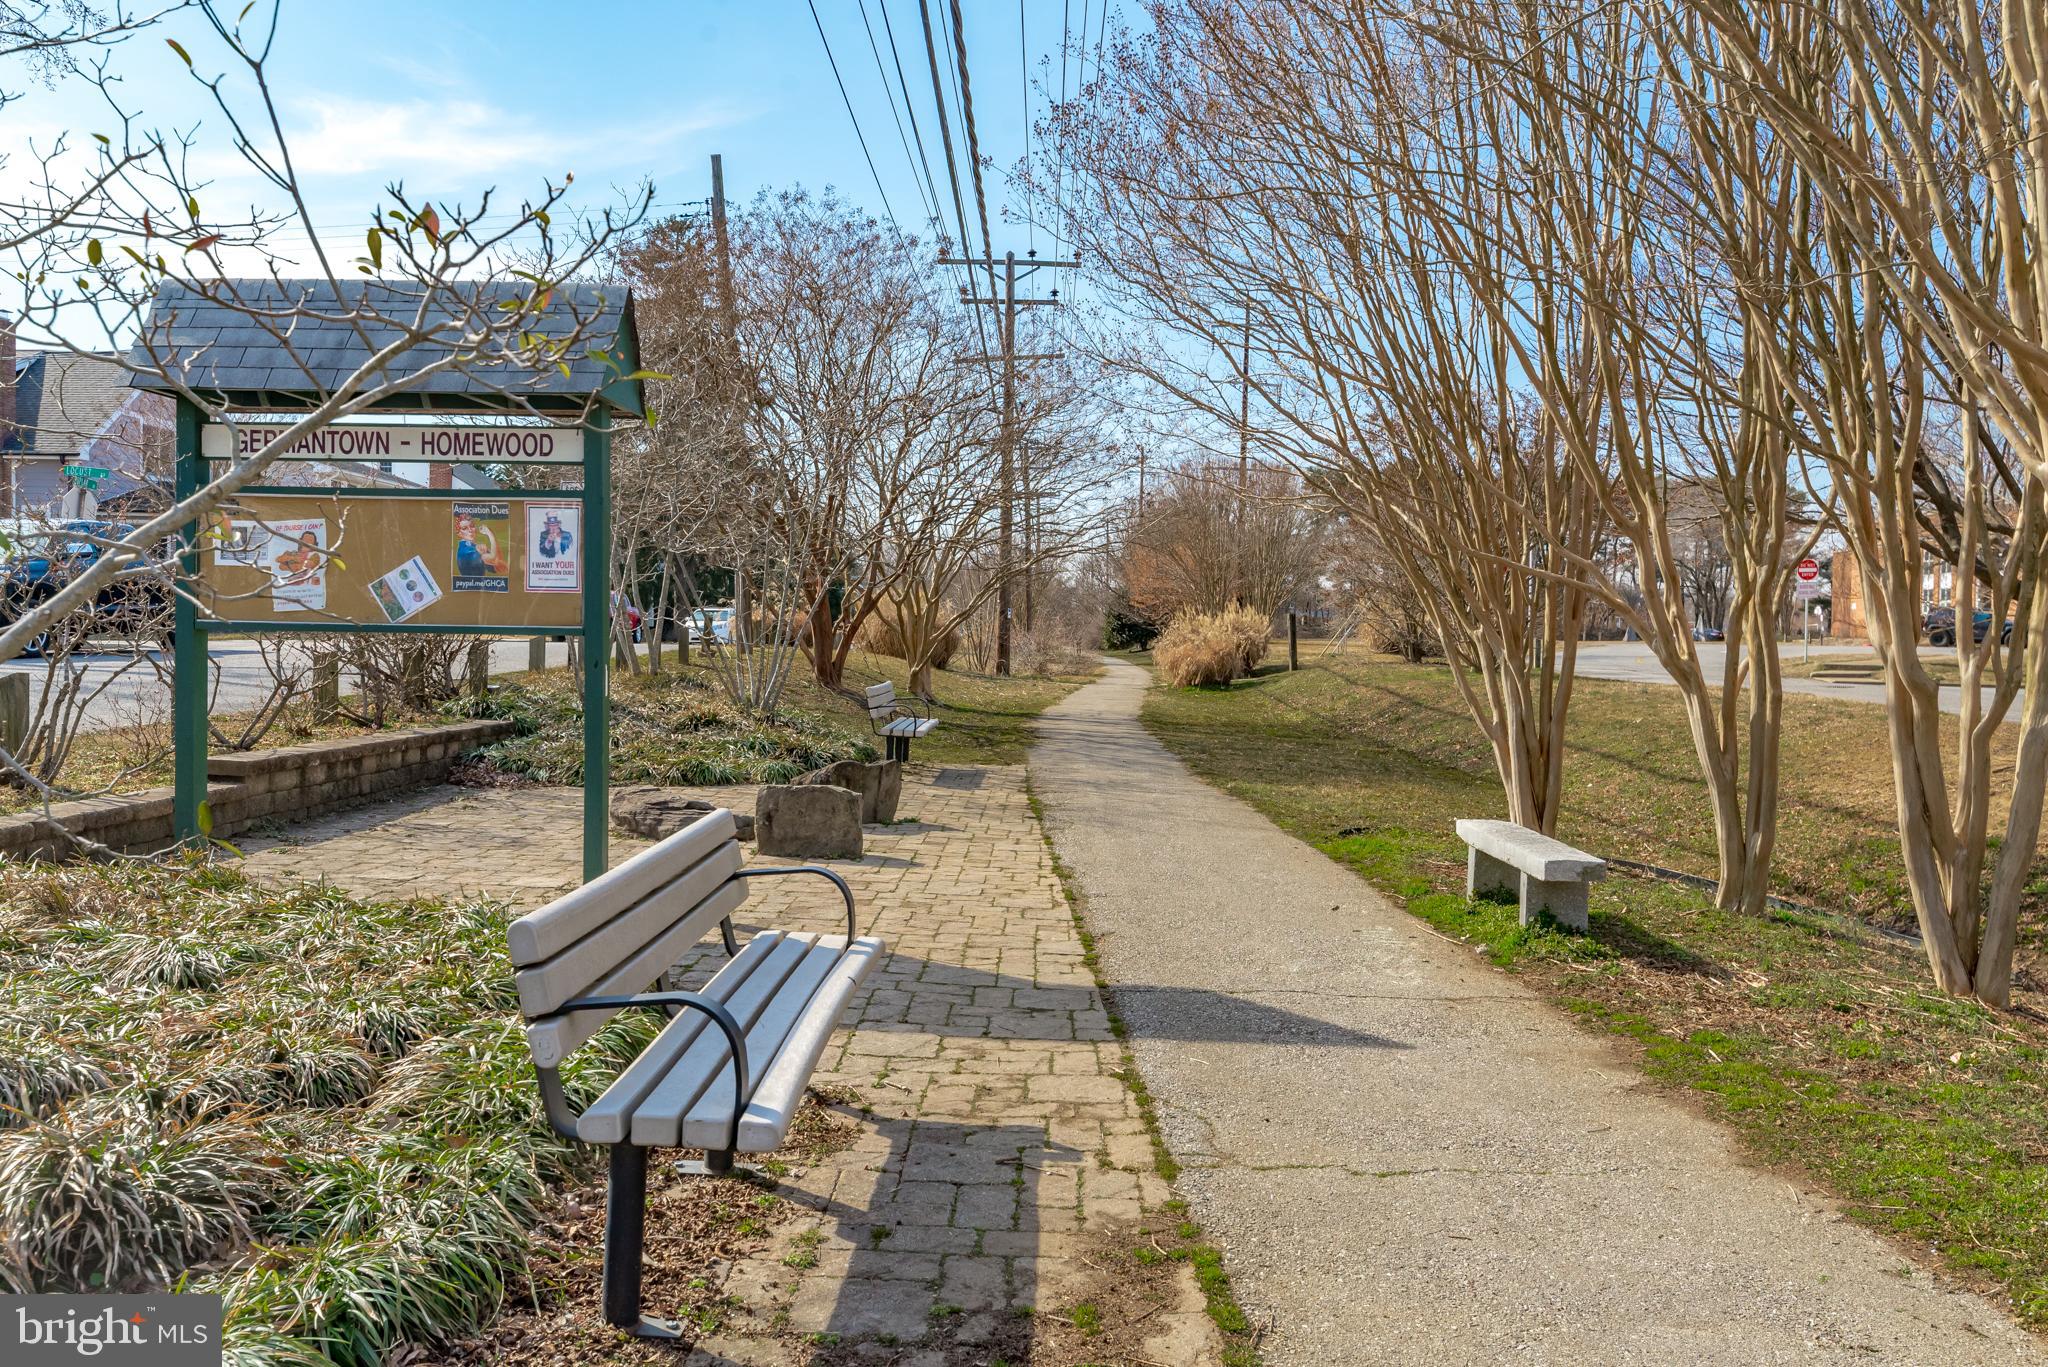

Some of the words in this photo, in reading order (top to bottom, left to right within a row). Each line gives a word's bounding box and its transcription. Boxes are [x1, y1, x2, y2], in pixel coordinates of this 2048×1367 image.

[421, 431, 554, 457] HOMEWOOD
[66, 466, 92, 477] LOCUST
[454, 504, 490, 514] Association
[491, 505, 509, 515] Dues
[555, 561, 575, 569] YOUR
[455, 579, 506, 589] paypal.me/GHCA
